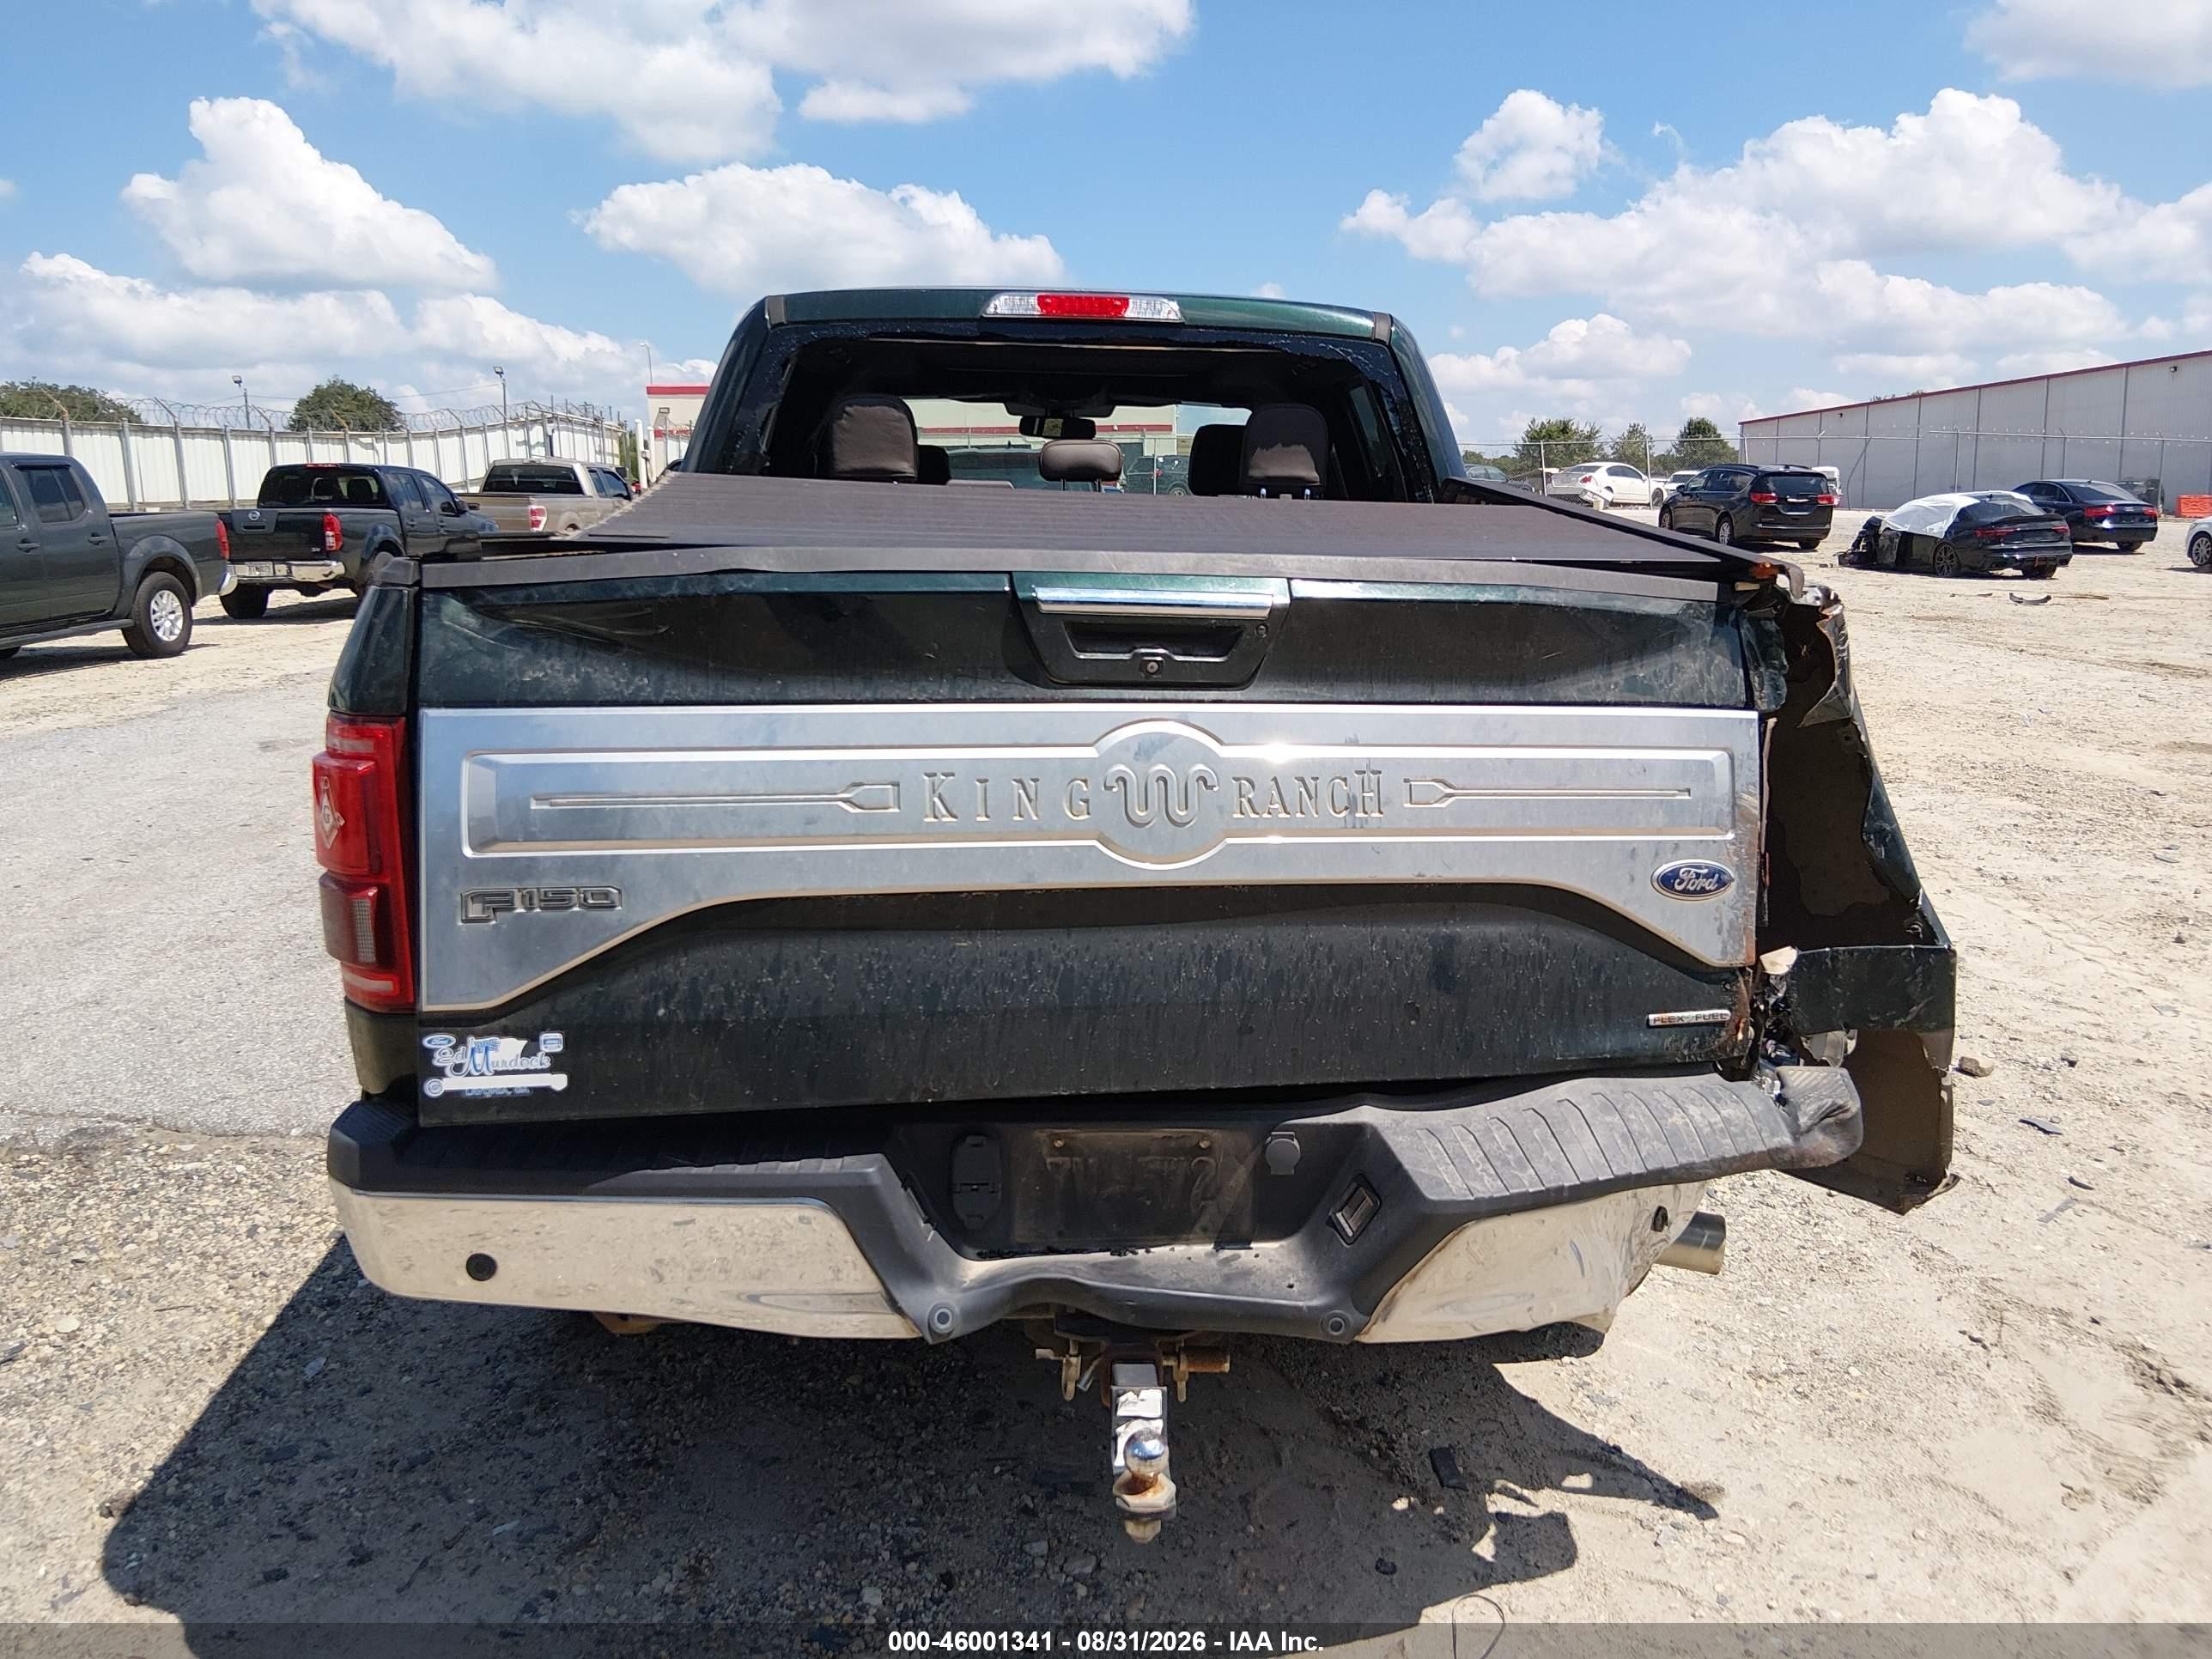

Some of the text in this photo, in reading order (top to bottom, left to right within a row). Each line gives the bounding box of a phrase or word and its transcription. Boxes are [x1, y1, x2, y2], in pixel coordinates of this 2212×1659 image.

[922, 769, 1384, 822] KING RANCH
[1674, 867, 1720, 891] Ford
[1653, 1012, 1729, 1024] FLEX FUEL
[434, 1036, 551, 1077] Ed Murdock
